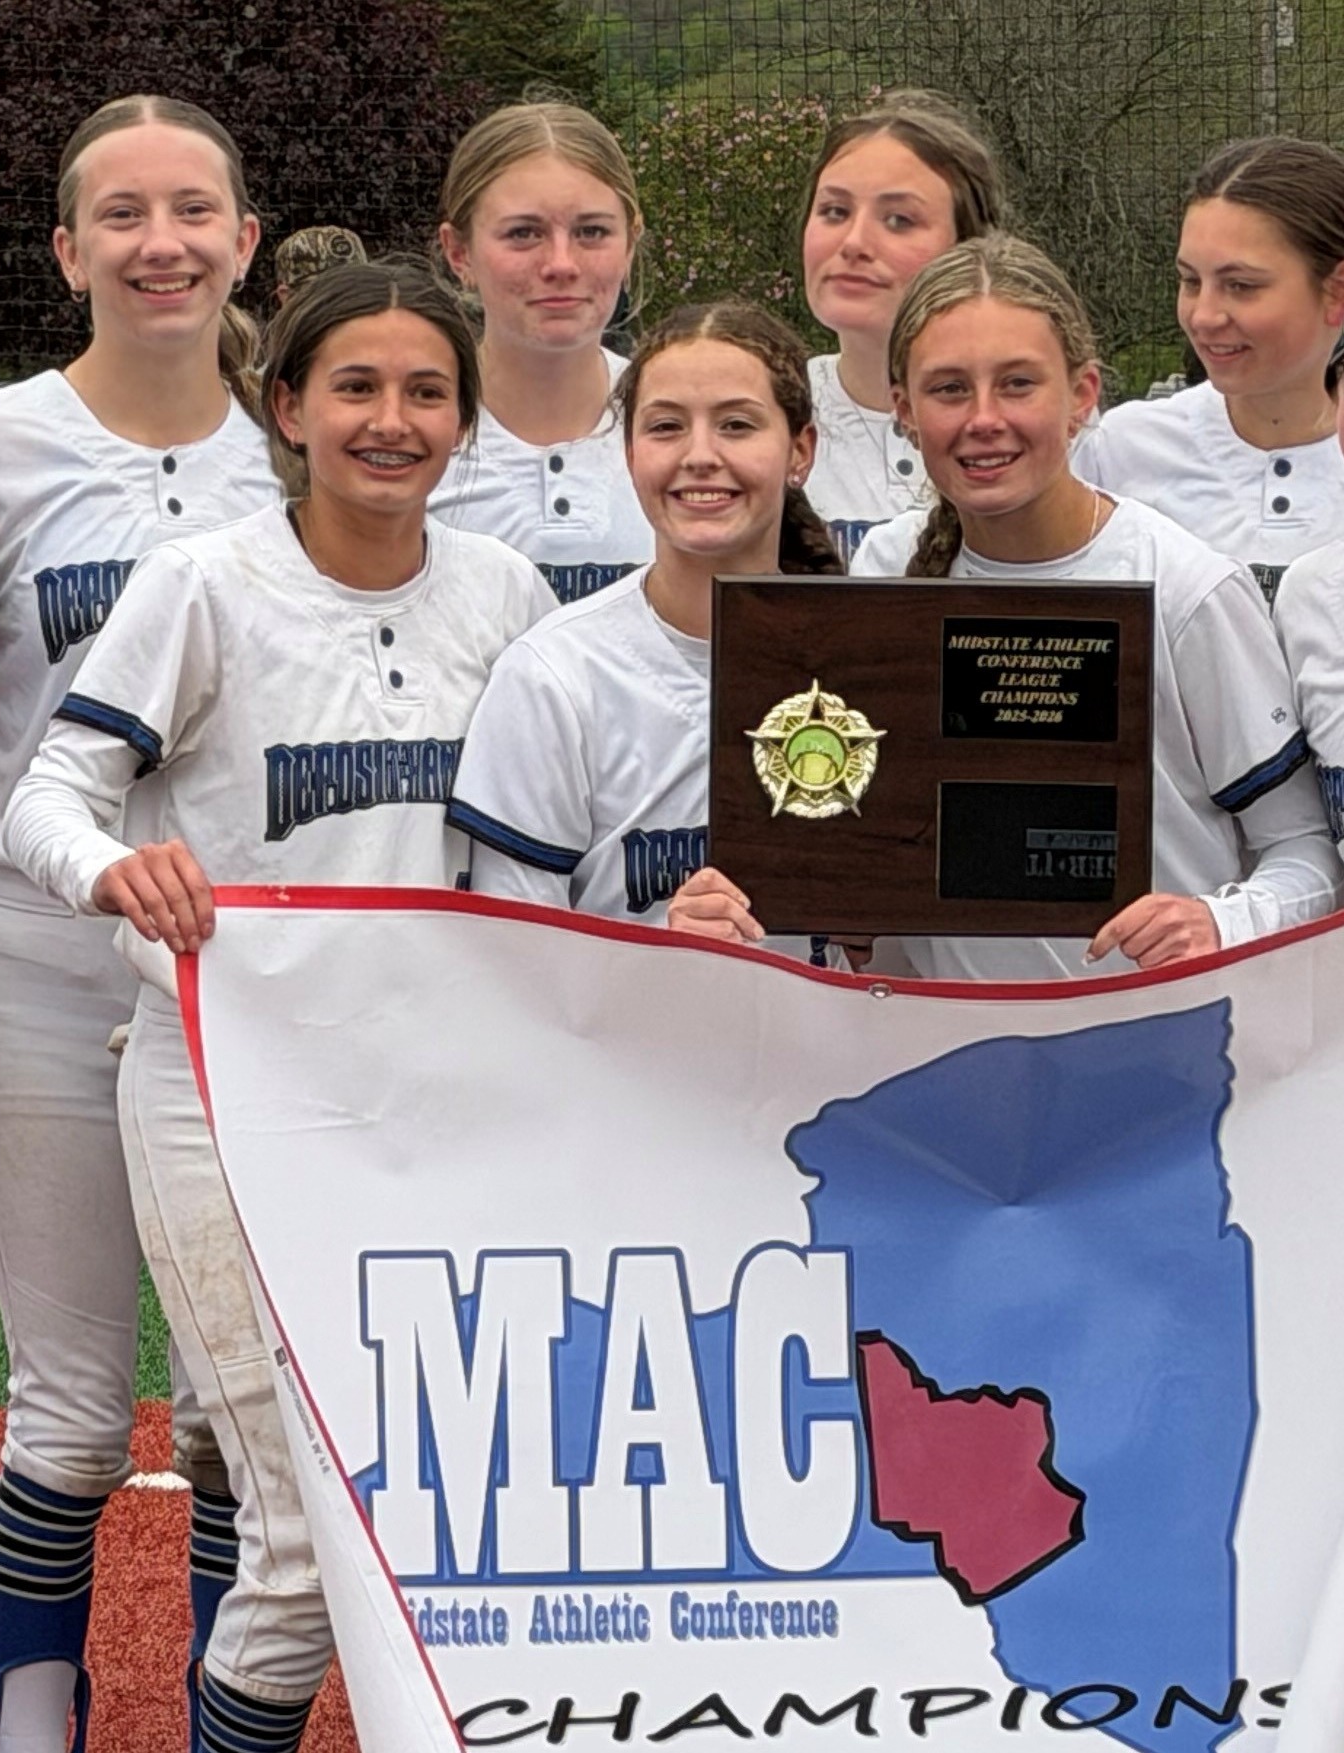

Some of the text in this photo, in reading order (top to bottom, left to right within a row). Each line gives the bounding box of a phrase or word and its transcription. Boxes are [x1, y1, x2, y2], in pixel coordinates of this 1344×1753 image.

[948, 636, 1114, 653] MIDSTATE ATHLETIC
[977, 654, 1084, 670] CONFERENCE
[998, 672, 1062, 687] LEAGUE
[980, 691, 1080, 706] CHAMPIONS
[358, 1240, 860, 1580] MAC
[407, 1589, 840, 1646] idstate Athletic Conference
